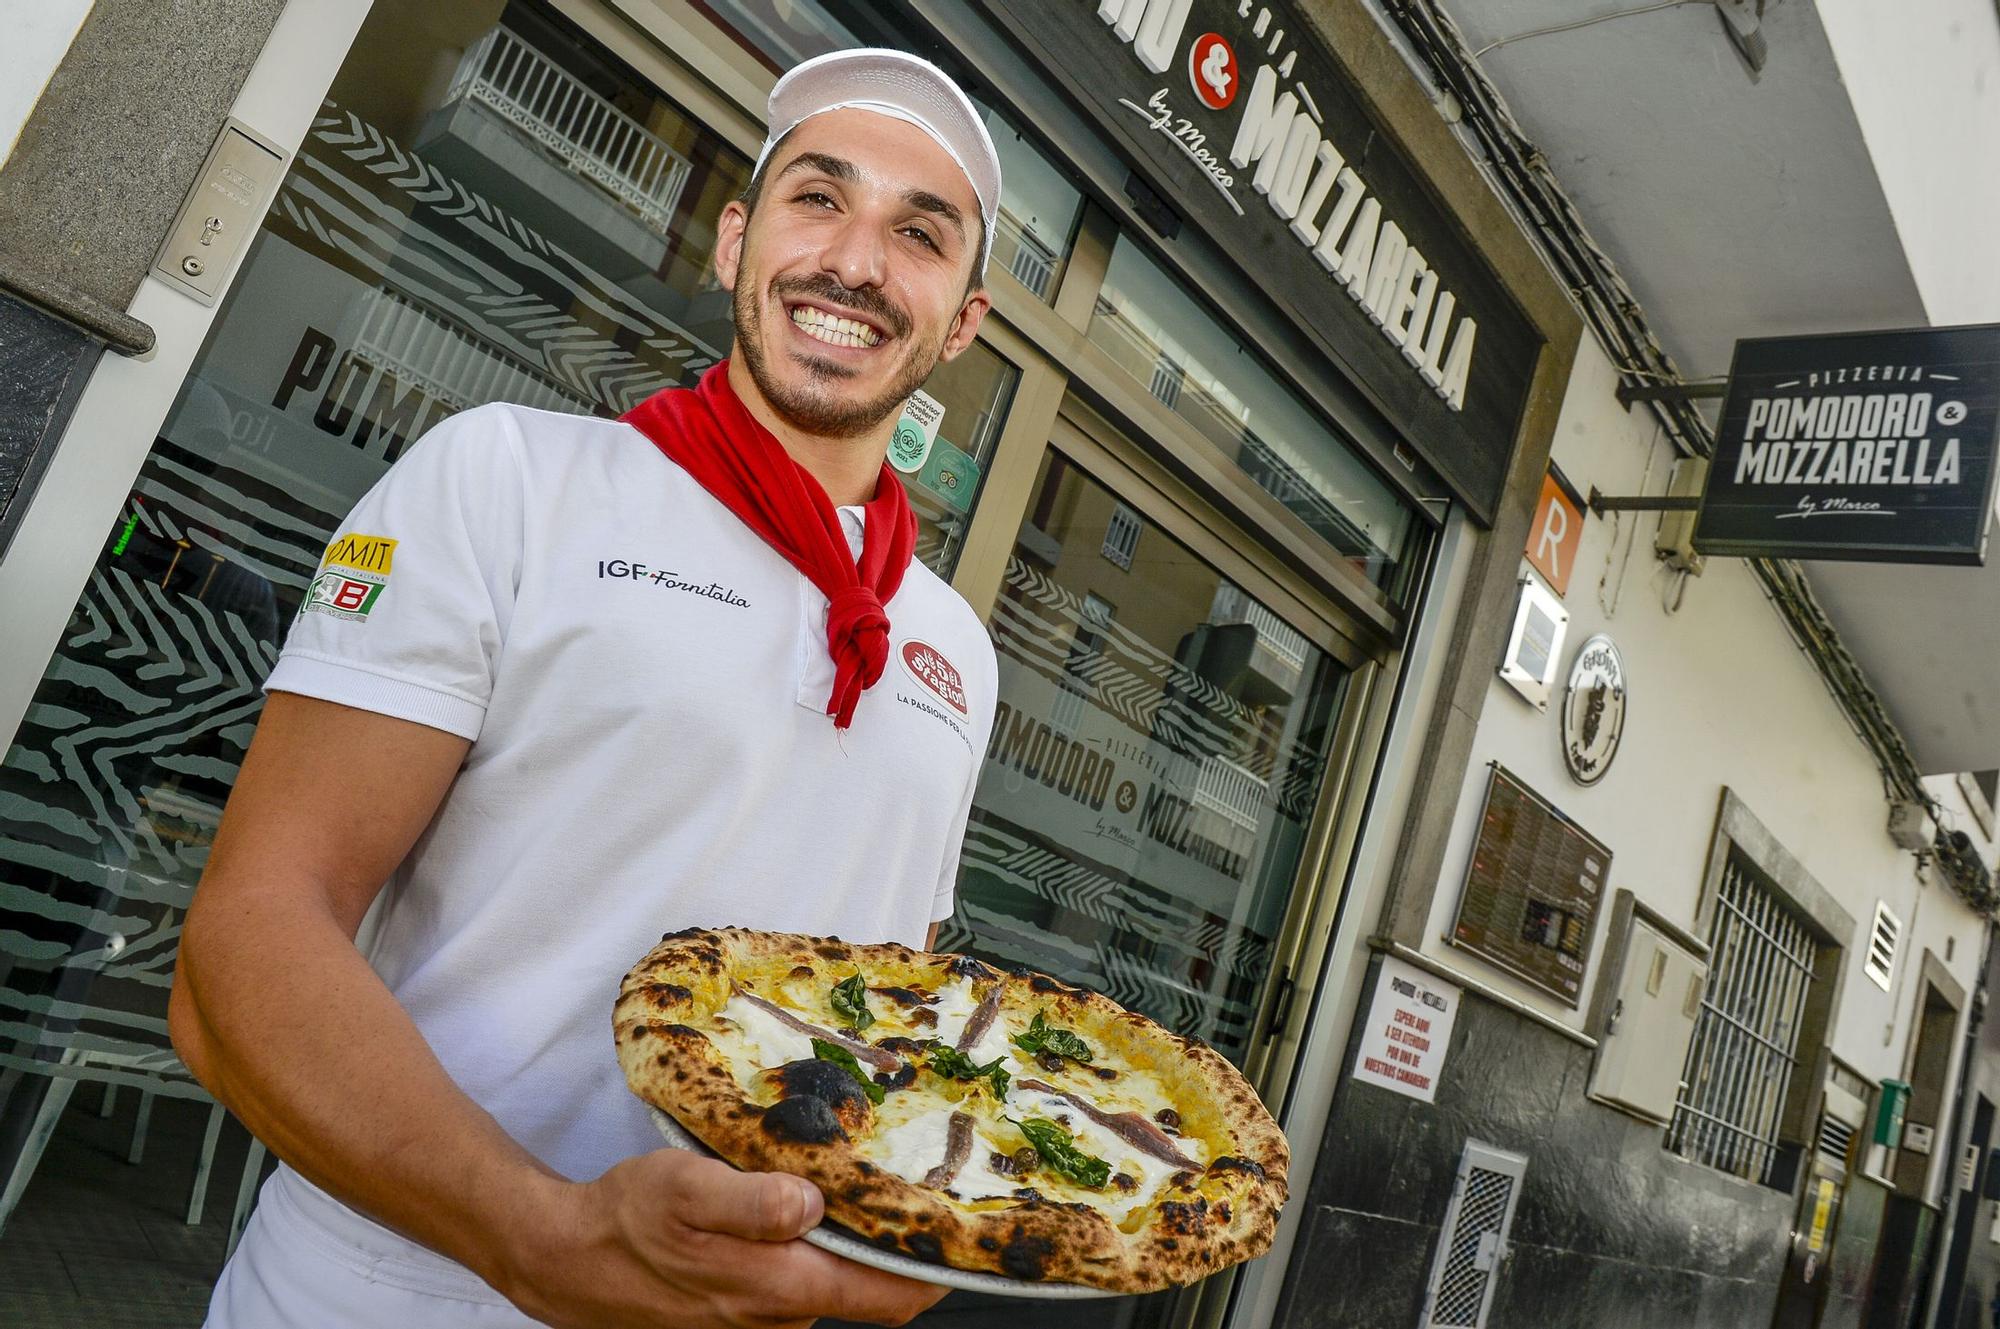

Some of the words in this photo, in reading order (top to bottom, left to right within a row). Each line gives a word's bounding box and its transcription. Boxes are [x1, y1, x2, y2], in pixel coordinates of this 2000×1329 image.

[1175, 118, 1234, 188] Marco
[1199, 41, 1234, 101] &
[1230, 63, 1477, 412] MOZZARELLA
[1808, 365, 1923, 389] PIZZERIA
[905, 406, 929, 427] Choice
[1743, 392, 1933, 440] POMODORO
[1733, 437, 1961, 485] MOZZARELLA
[1821, 498, 1881, 511] Marco
[1537, 497, 1567, 578] R
[598, 559, 648, 581] IGF
[649, 570, 751, 608] Fornitalia
[896, 692, 910, 705] LA
[911, 698, 949, 726] PASSIONE
[1106, 737, 1167, 779] PIZZERIA
